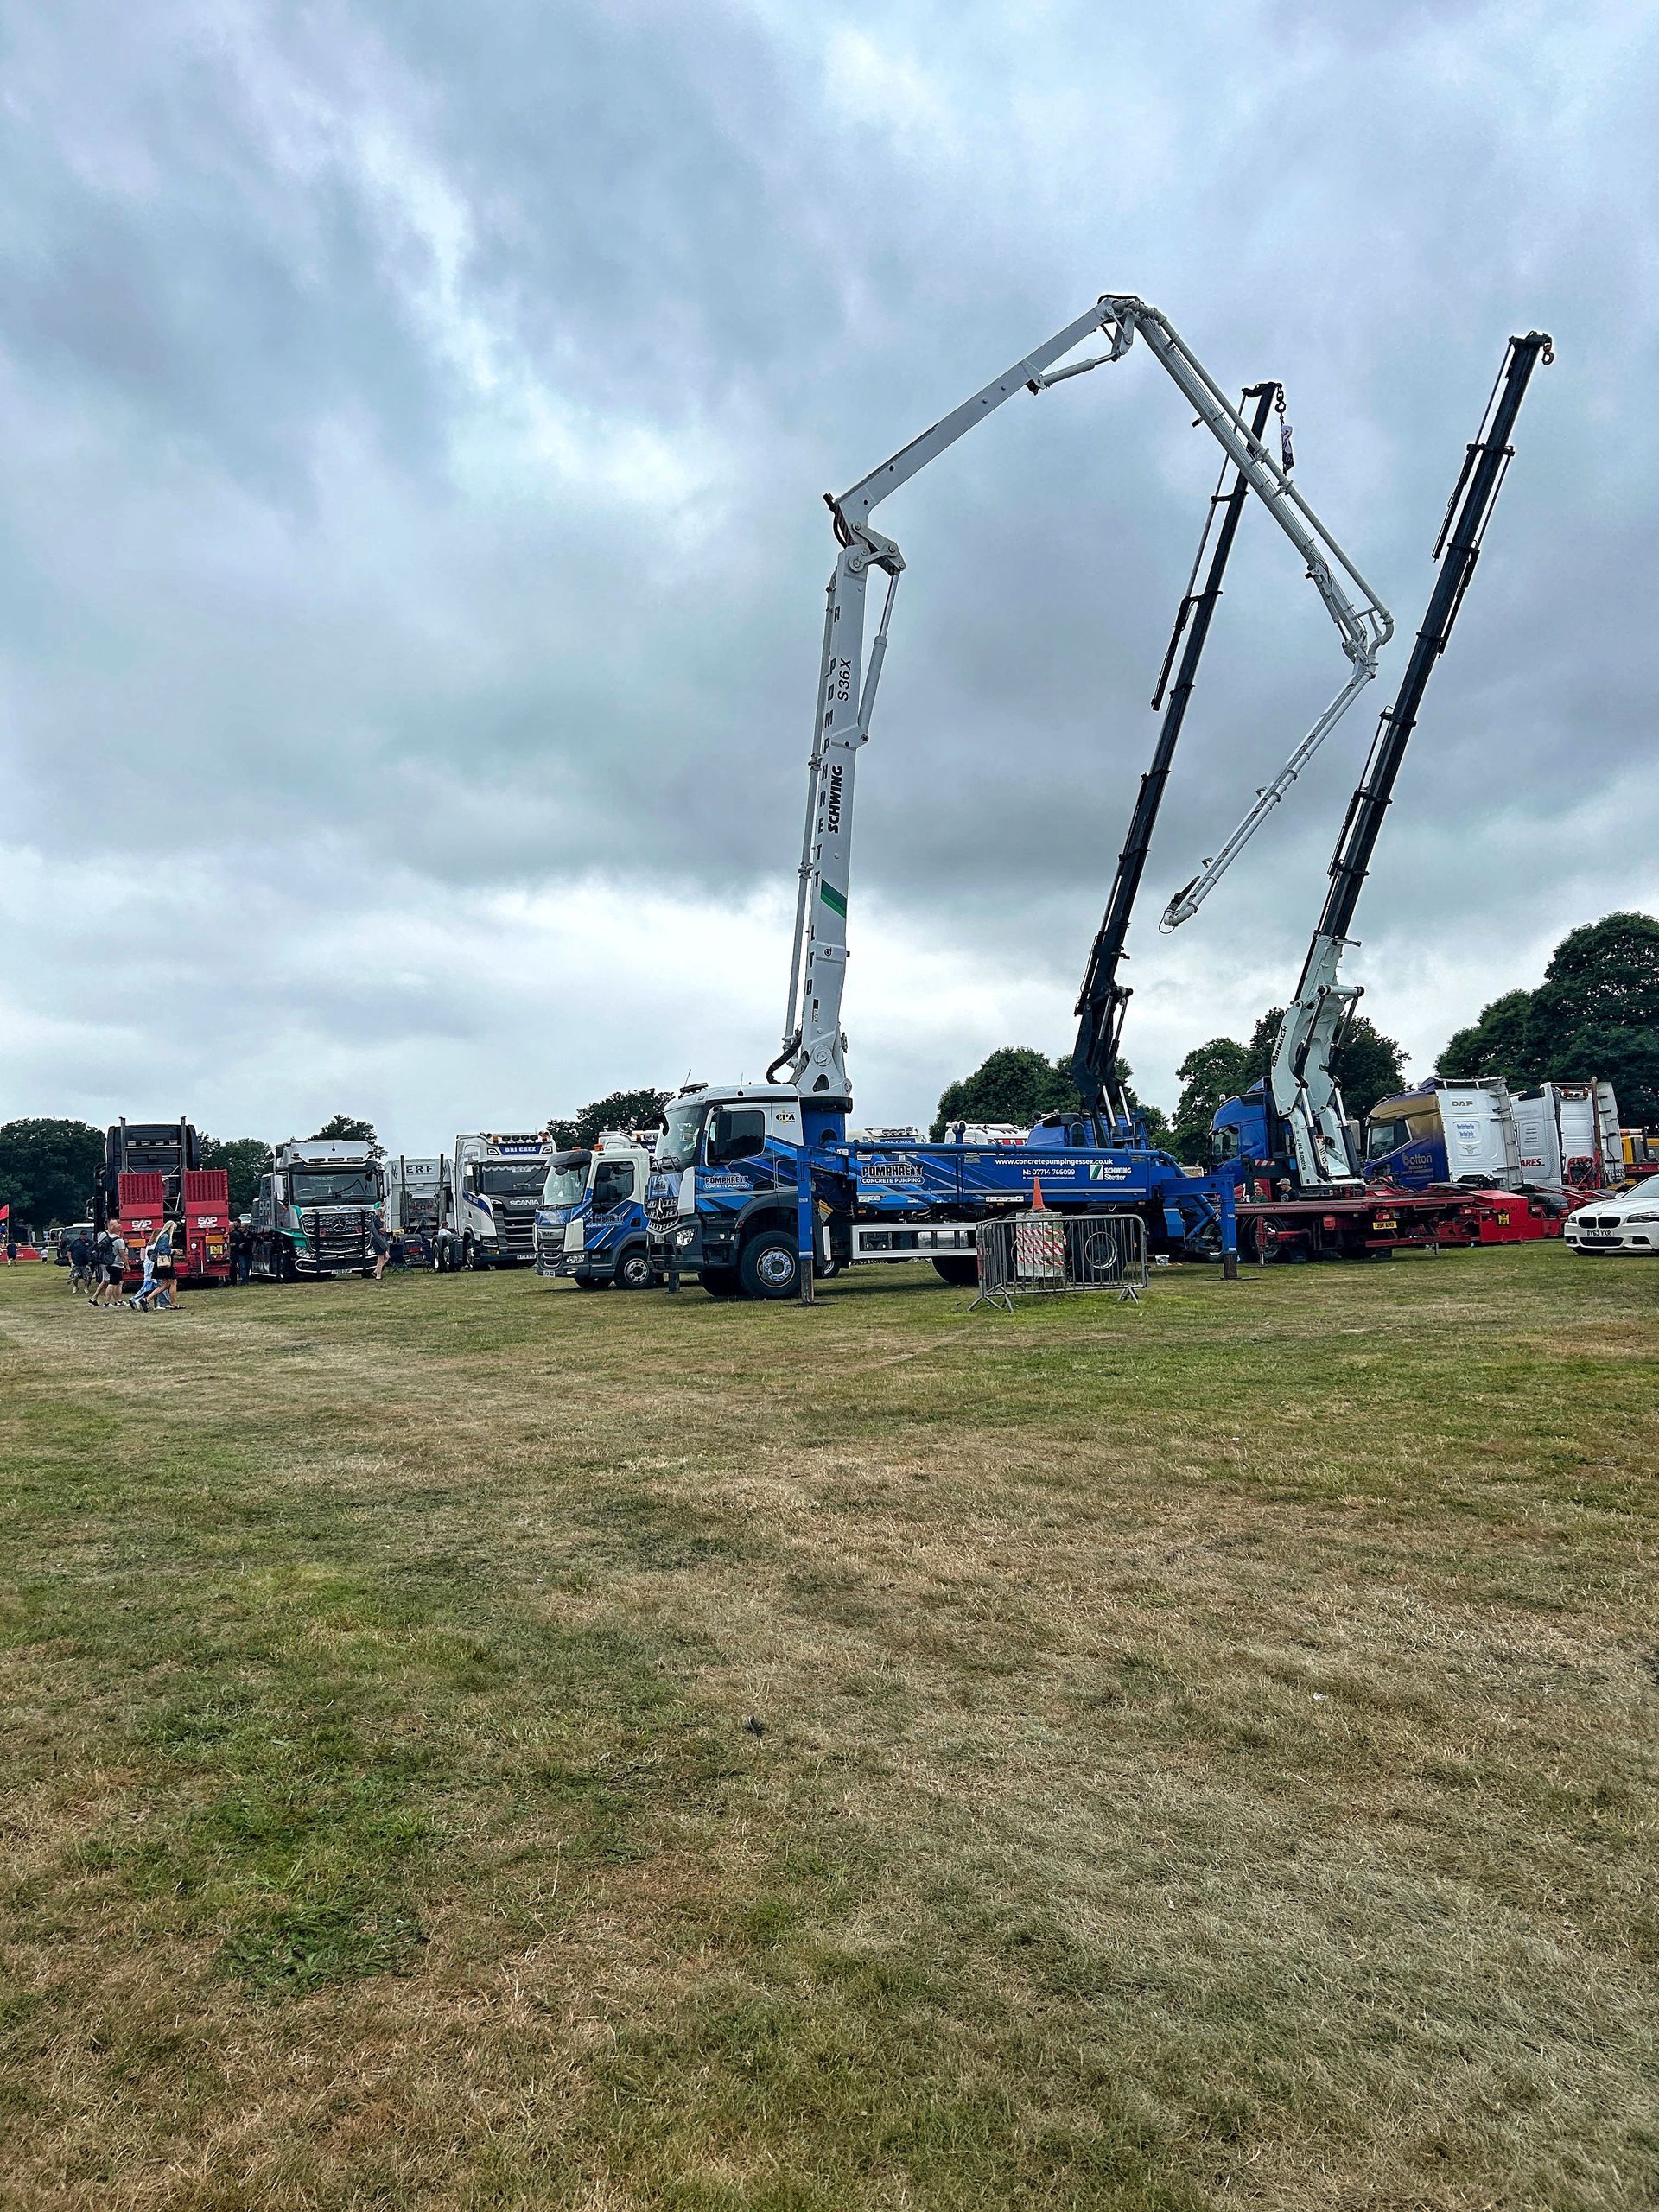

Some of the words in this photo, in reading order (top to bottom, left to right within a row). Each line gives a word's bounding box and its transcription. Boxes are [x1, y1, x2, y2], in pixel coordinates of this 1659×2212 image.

[828, 765, 843, 835] SCHWING
[995, 1158, 1114, 1166] www.concretepumpingessex.co.uk
[1402, 1152, 1433, 1166] Bolton
[405, 1165, 433, 1173] ERF
[861, 1166, 923, 1176] POMPHRETT
[705, 1175, 748, 1184] POMPHRETT
